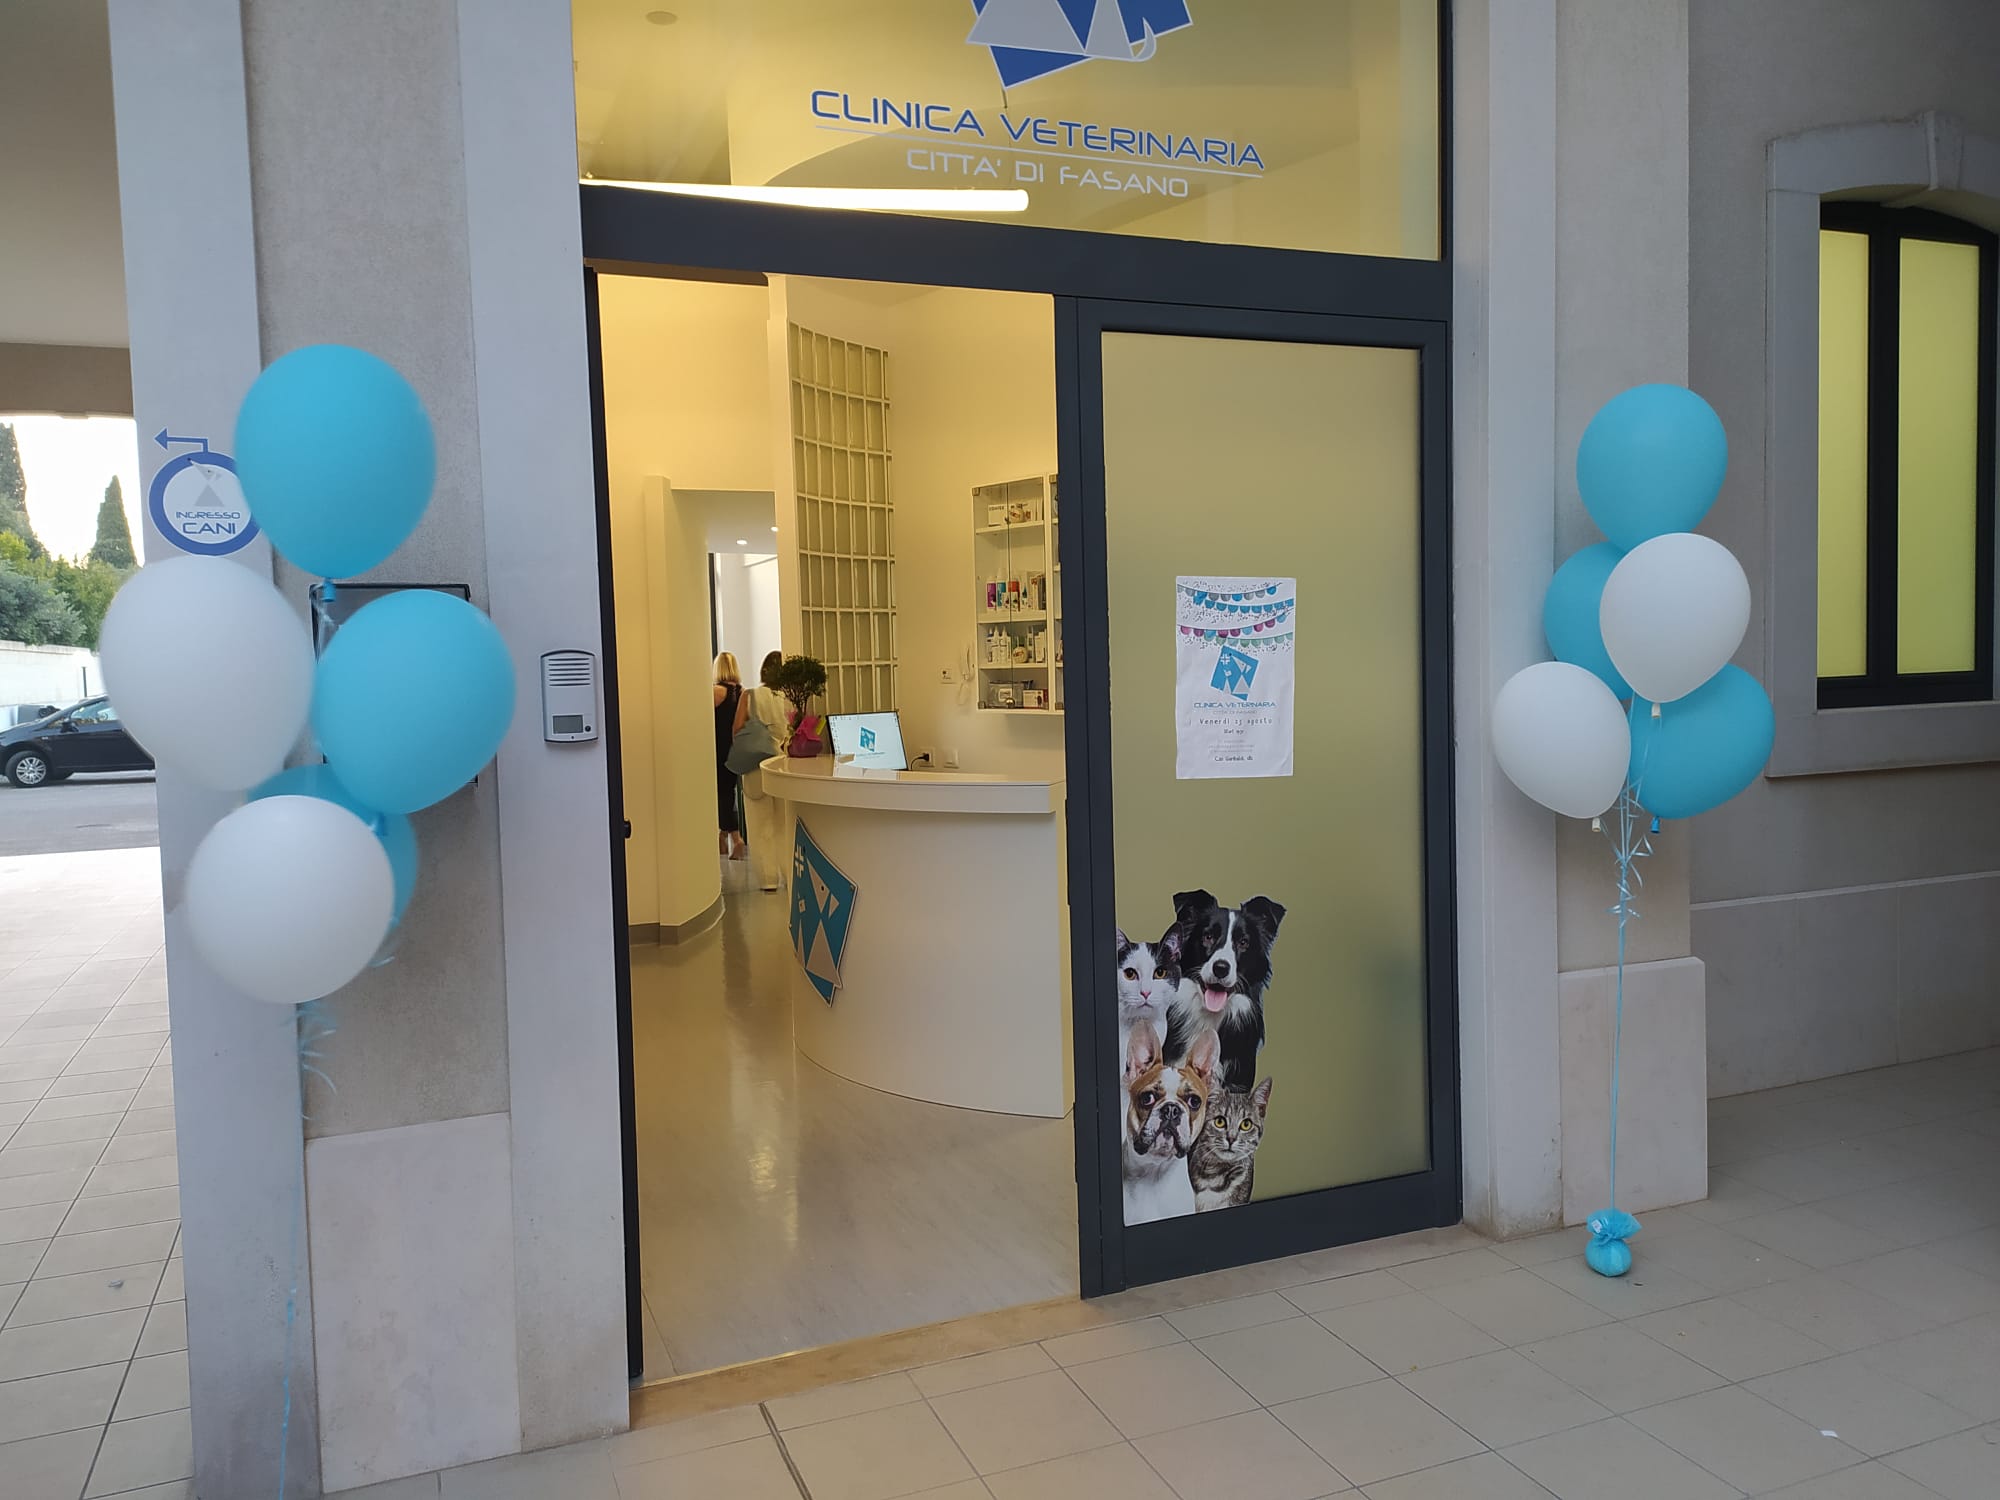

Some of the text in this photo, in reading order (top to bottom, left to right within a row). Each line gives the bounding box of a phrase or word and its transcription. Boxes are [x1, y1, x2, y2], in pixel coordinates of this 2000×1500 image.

[811, 90, 1265, 170] CLINICA VETERINARIA
[906, 148, 1189, 197] CITTA' DI FASANO
[176, 511, 241, 519] INGRESSO
[183, 522, 236, 534] CANI
